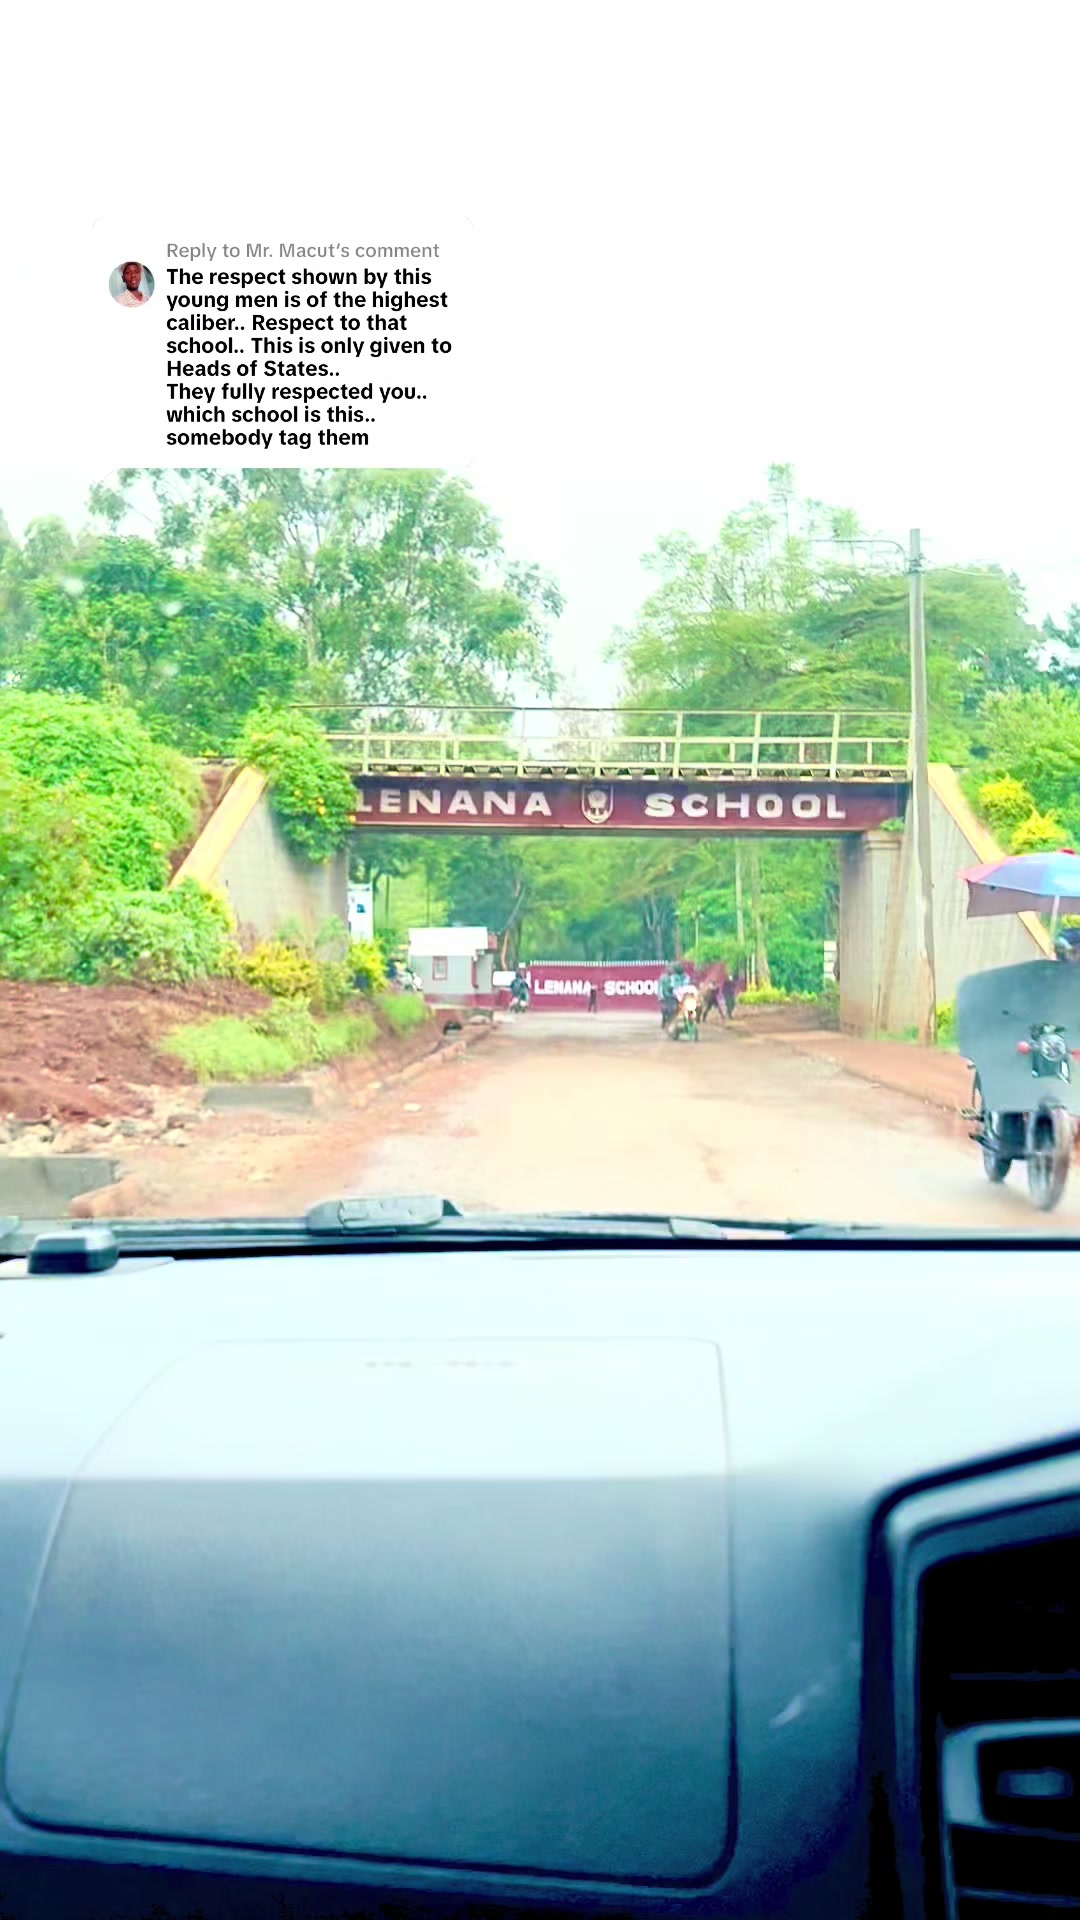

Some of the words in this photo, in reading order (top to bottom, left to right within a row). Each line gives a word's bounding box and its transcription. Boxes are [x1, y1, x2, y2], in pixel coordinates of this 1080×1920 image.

[355, 788, 552, 817] LENANA
[644, 792, 847, 819] SCHOOL
[534, 979, 591, 995] LENANA
